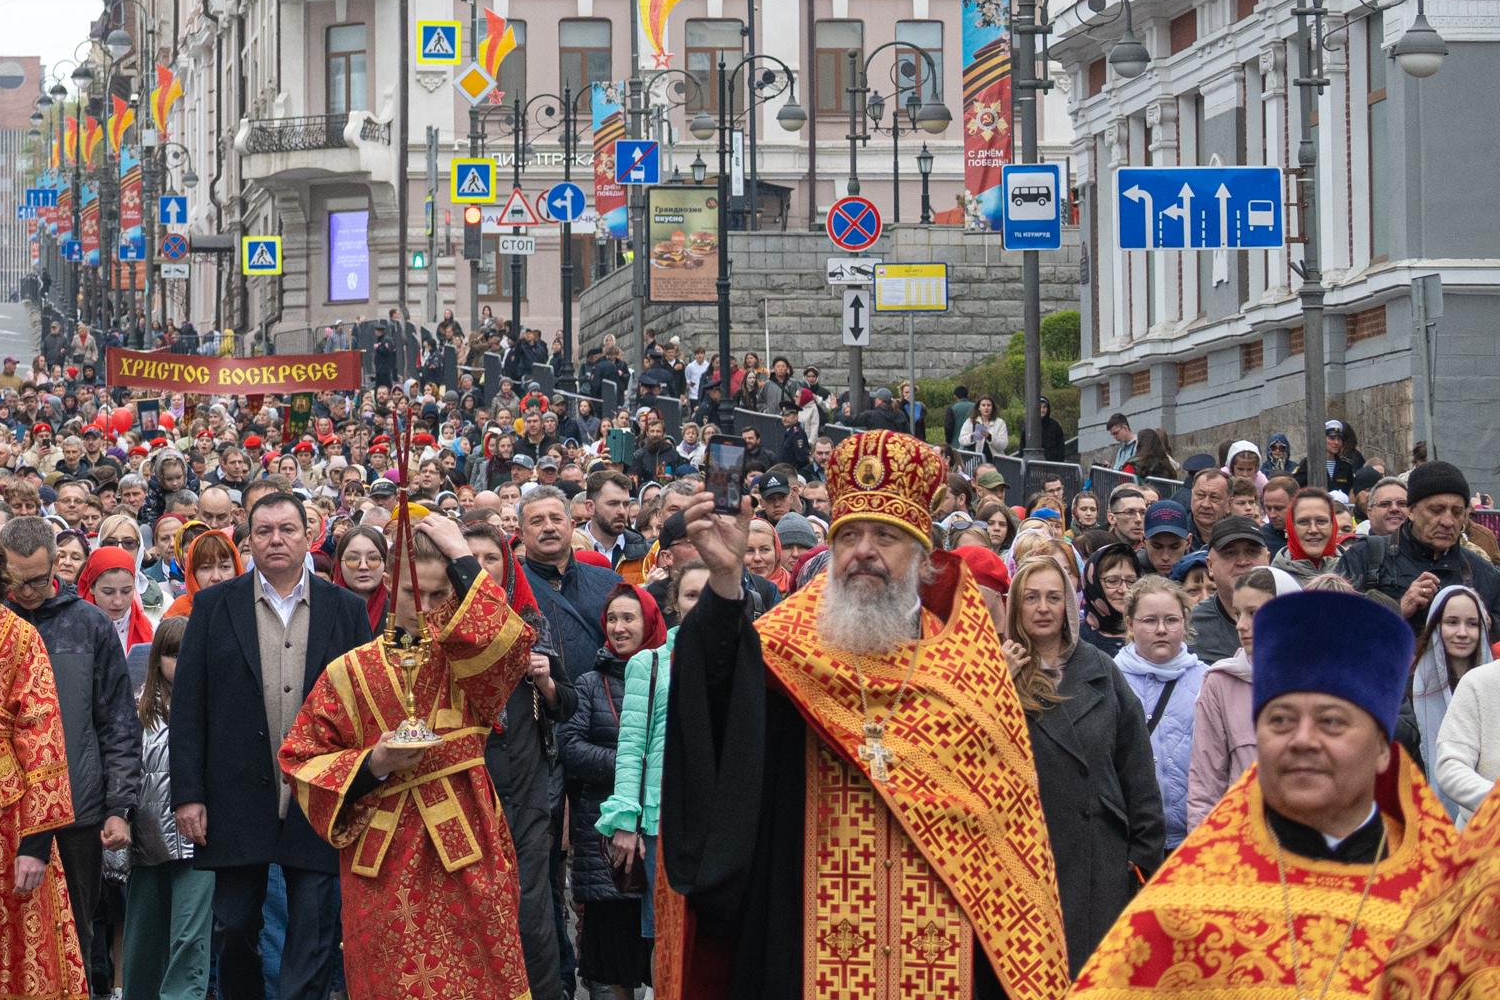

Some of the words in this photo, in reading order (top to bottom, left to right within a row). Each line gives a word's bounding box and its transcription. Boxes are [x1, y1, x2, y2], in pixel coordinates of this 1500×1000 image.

[968, 150, 975, 158] С
[978, 148, 1004, 159] ДНЁМ
[655, 206, 702, 214] Грандиозно
[501, 240, 533, 251] СТОП
[119, 357, 211, 384] ХРИСТОС
[218, 361, 338, 385] ВОСКРЕСЕ
